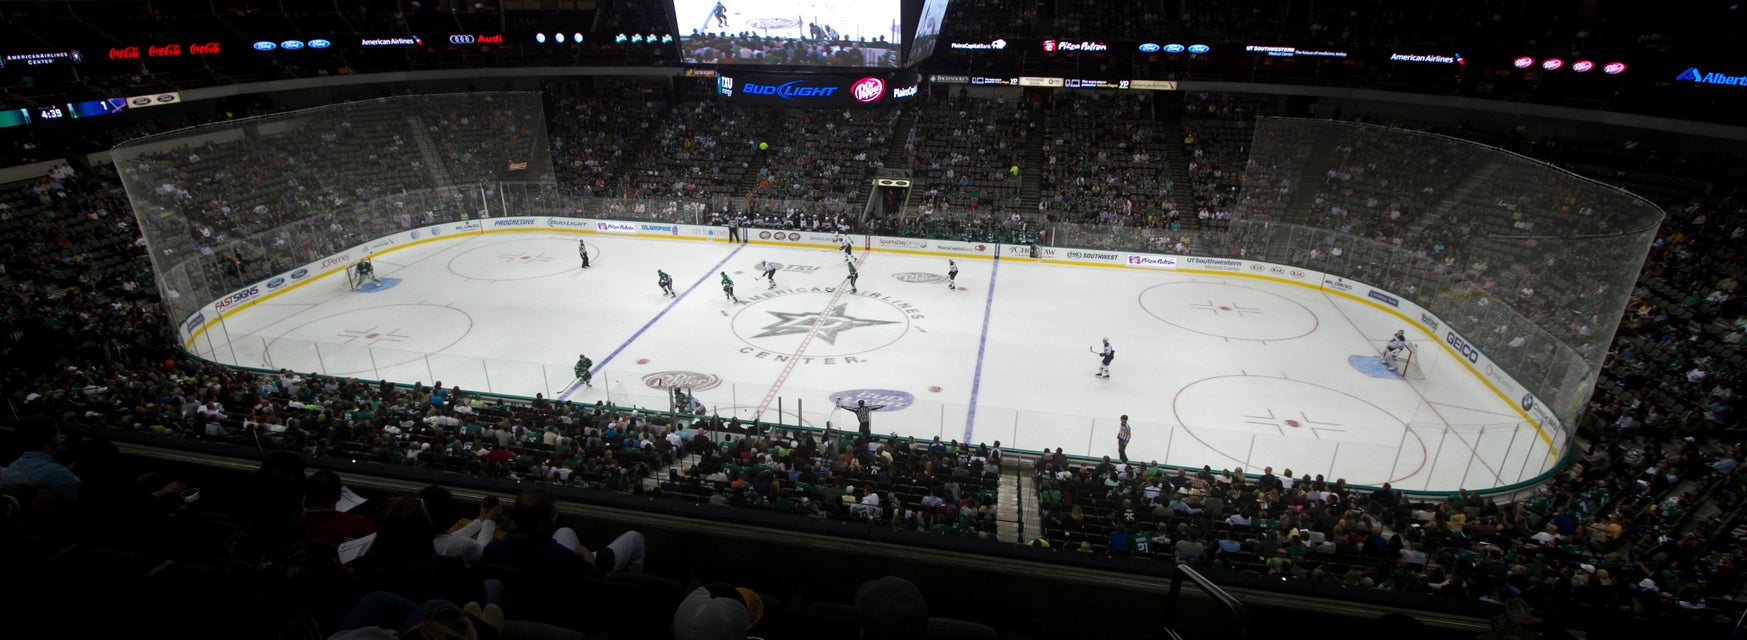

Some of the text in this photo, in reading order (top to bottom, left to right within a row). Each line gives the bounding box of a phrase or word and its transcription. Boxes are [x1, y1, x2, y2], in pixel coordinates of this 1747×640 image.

[477, 34, 503, 44] Audi
[1058, 41, 1080, 51] Pizza
[1390, 53, 1453, 64] American Airlines
[1702, 72, 1747, 86] Albert
[743, 83, 839, 97] BUD LIGHT
[41, 108, 62, 119] 4:39
[494, 218, 536, 227] PROGRESSIVE
[1083, 252, 1119, 261] SOUTHWEST
[1195, 258, 1242, 267] Southwestern
[215, 285, 260, 312] FASTSIGNS
[1446, 331, 1479, 364] GEICO
[739, 346, 862, 366] CENTER
